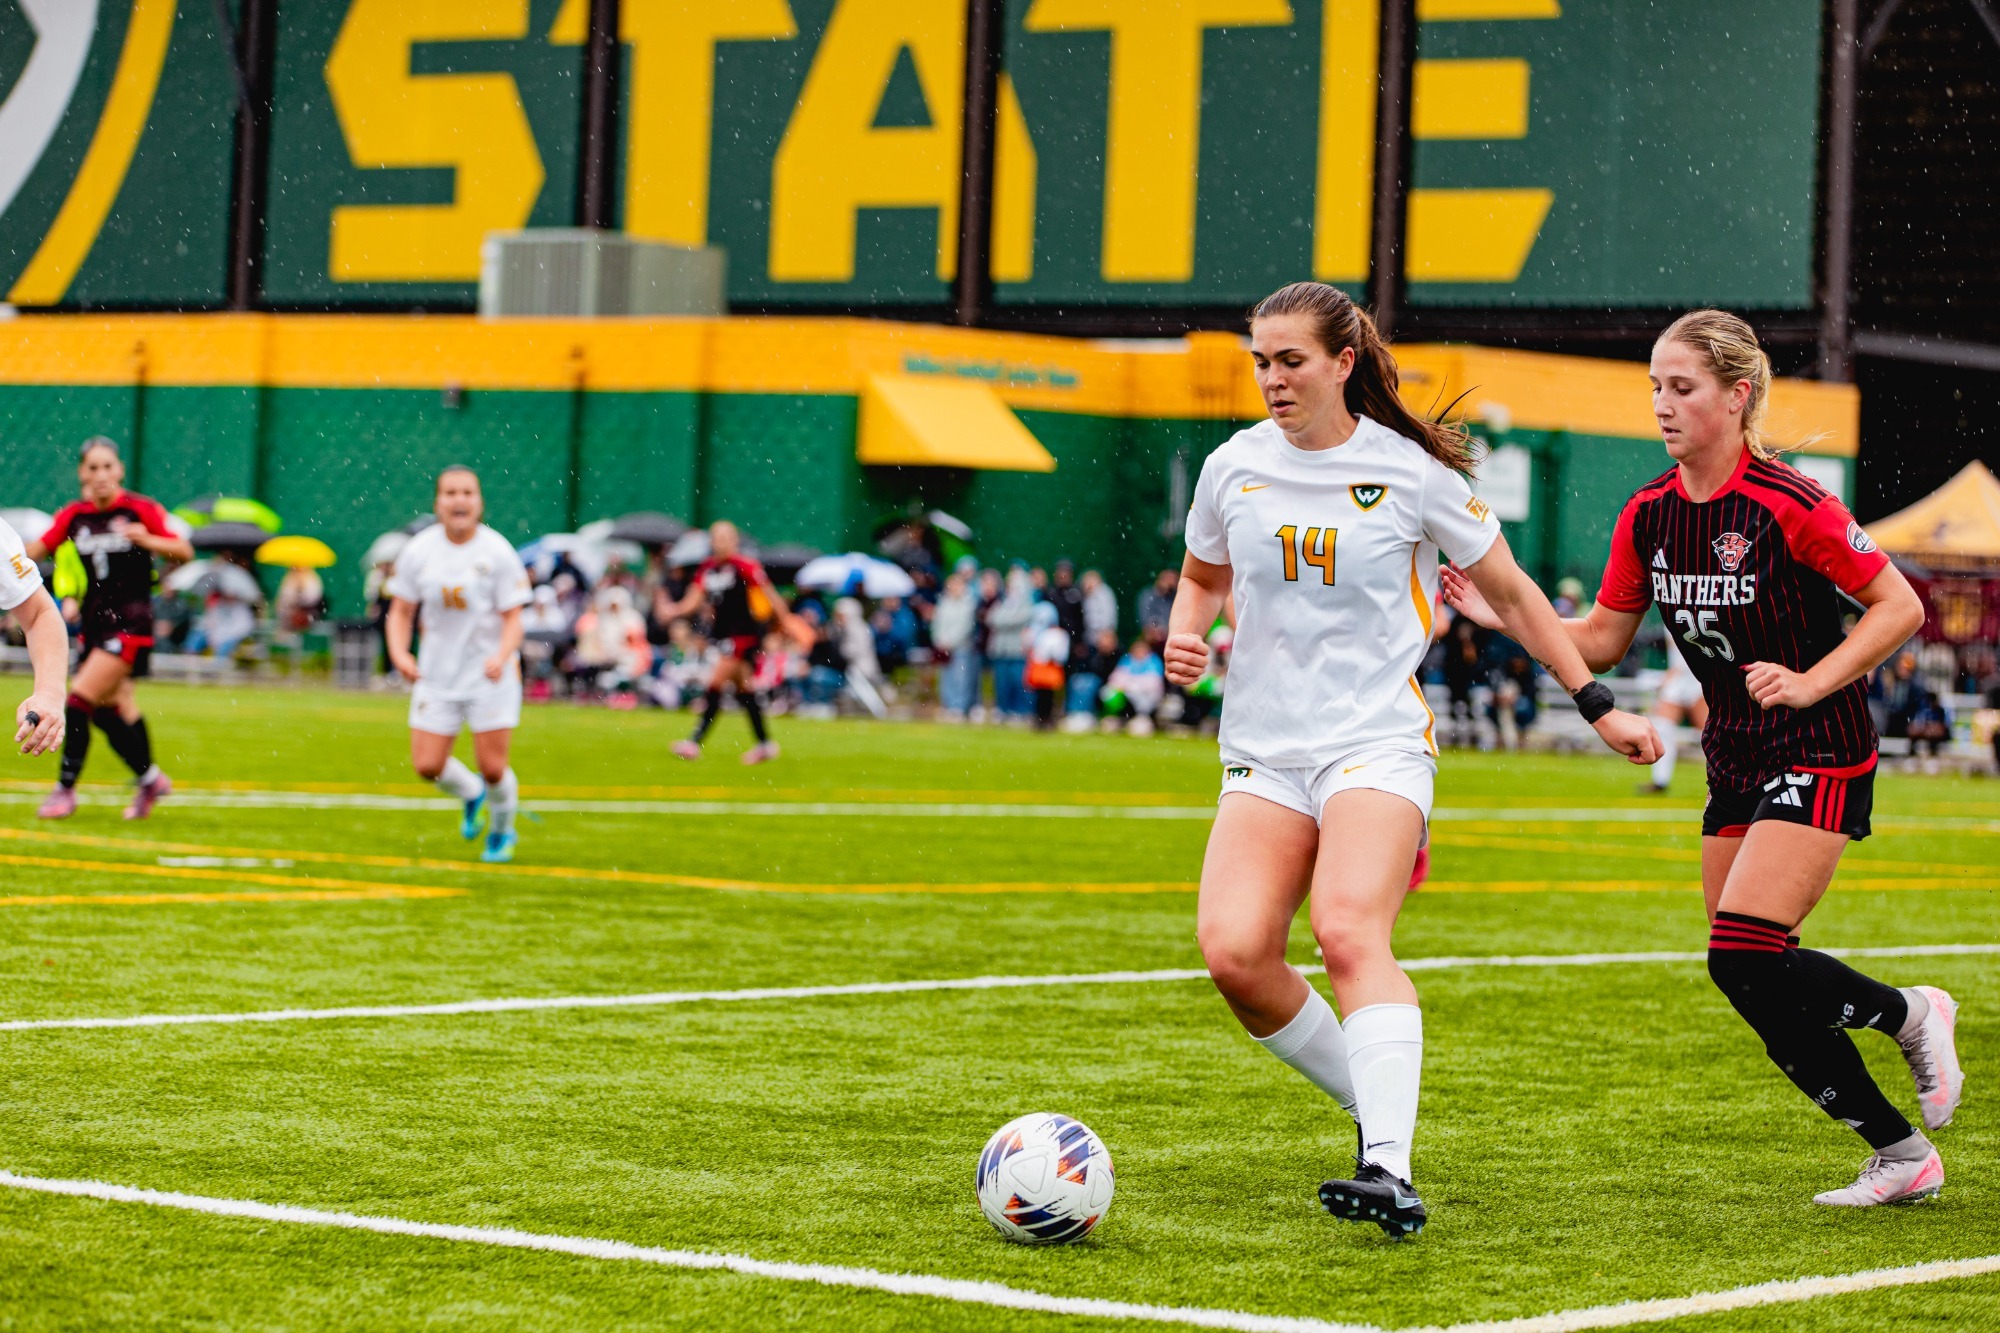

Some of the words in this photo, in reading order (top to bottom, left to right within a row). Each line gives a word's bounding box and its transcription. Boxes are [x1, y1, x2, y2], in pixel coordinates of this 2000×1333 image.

[324, 0, 1561, 283] STATE
[1274, 525, 1338, 586] 14
[1651, 571, 1756, 606] PANTHERS
[1675, 609, 1735, 661] 25
